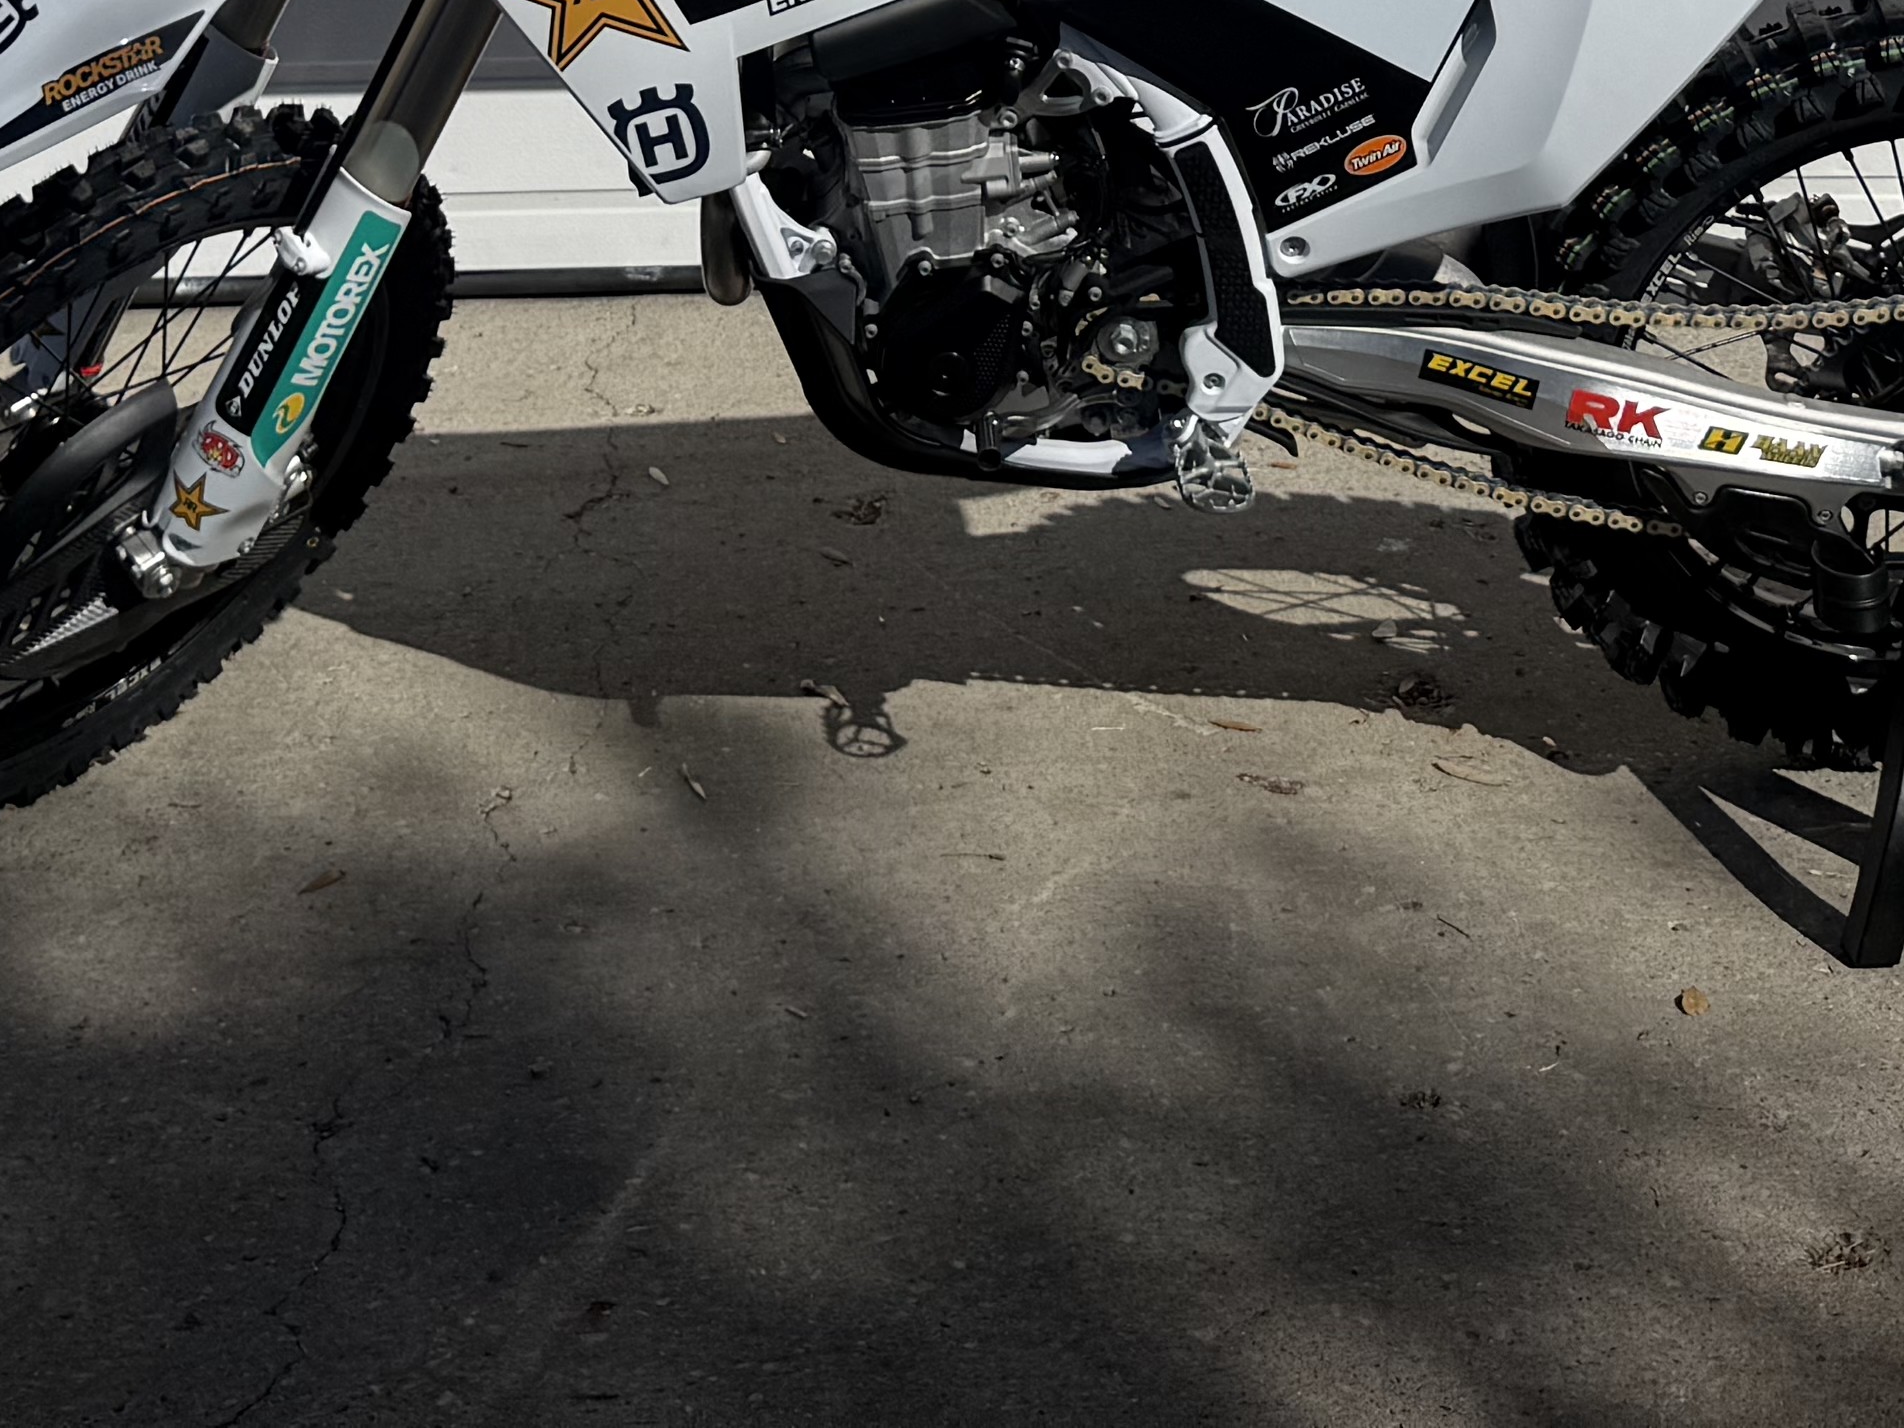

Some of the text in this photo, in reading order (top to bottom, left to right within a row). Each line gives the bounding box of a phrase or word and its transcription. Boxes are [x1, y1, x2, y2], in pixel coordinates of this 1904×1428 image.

[44, 35, 164, 106] ROCKSTAR
[61, 60, 158, 112] ENERGY DRINK
[1245, 77, 1366, 137] PARADISE
[1291, 113, 1376, 162] REKLUSE
[1350, 139, 1402, 171] Twin Air
[290, 242, 390, 386] MOTOREX
[1427, 352, 1532, 397] EXCEL
[1564, 419, 1663, 449] TAKASAGO CHAIN
[1567, 388, 1672, 439] RK
